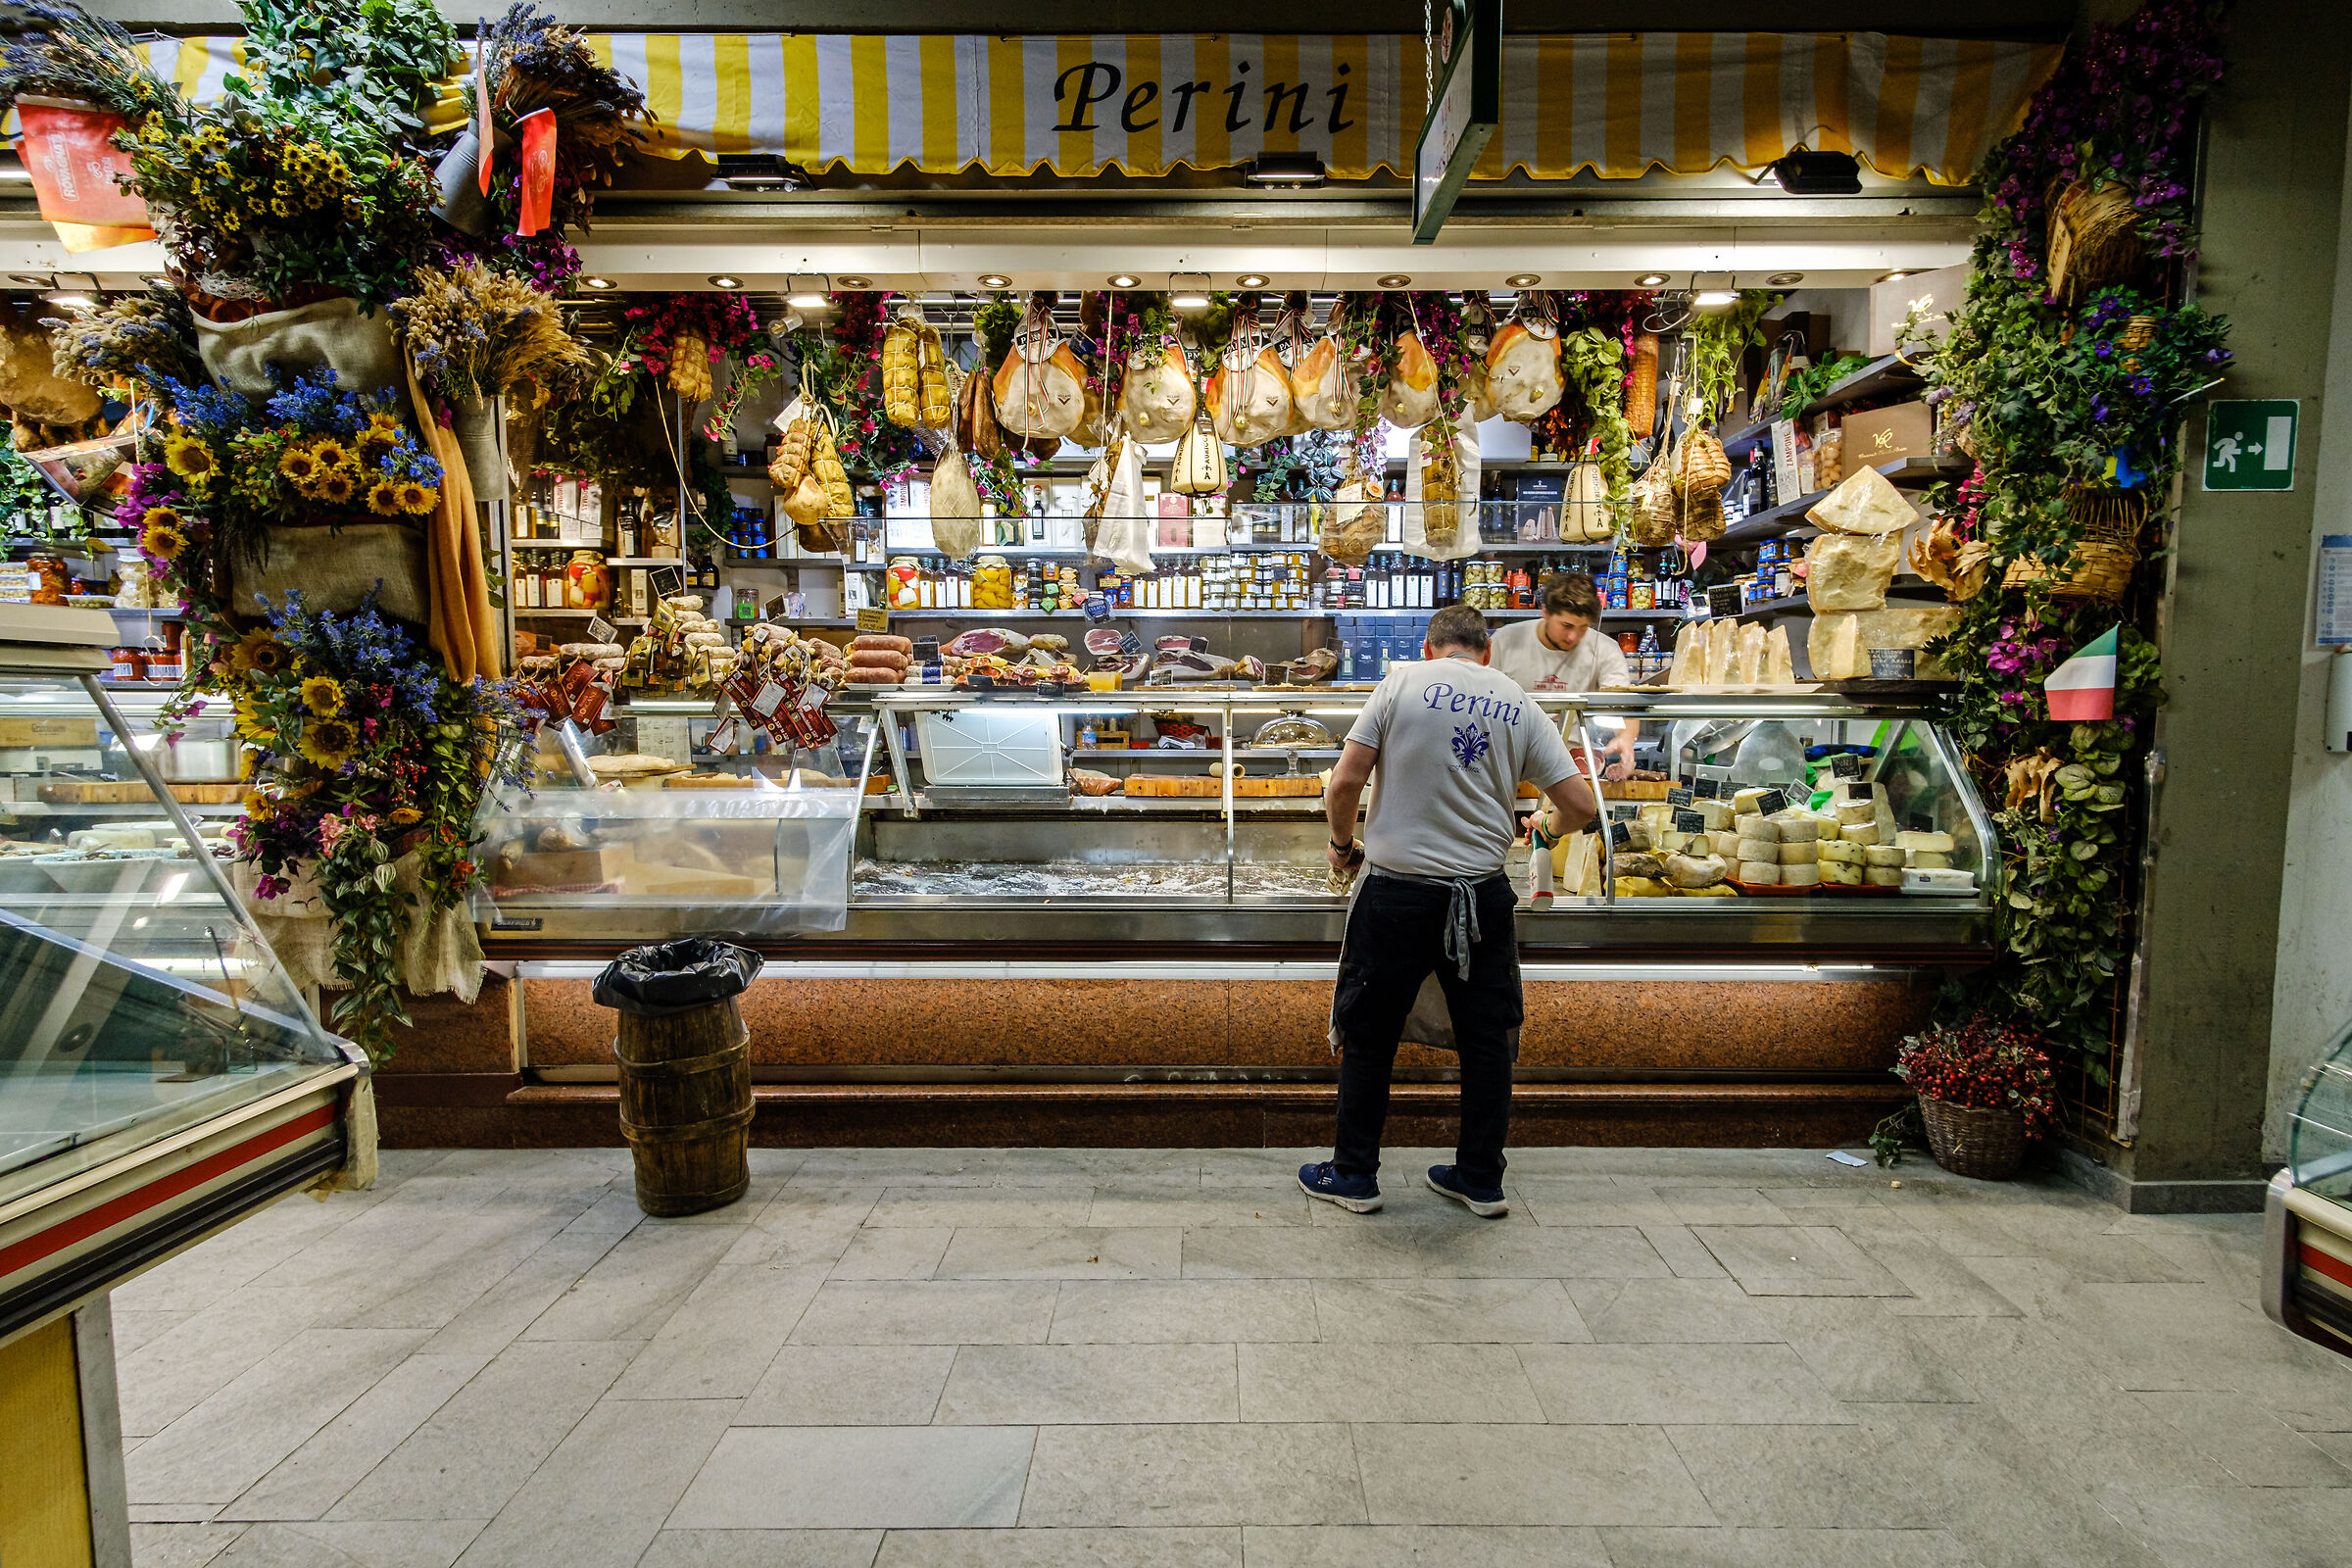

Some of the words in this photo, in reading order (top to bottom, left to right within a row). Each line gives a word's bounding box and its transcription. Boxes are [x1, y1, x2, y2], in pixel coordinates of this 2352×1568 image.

[1051, 60, 1354, 134] Perini
[1783, 430, 1794, 467] ZAMPONE
[1423, 682, 1523, 726] Perini
